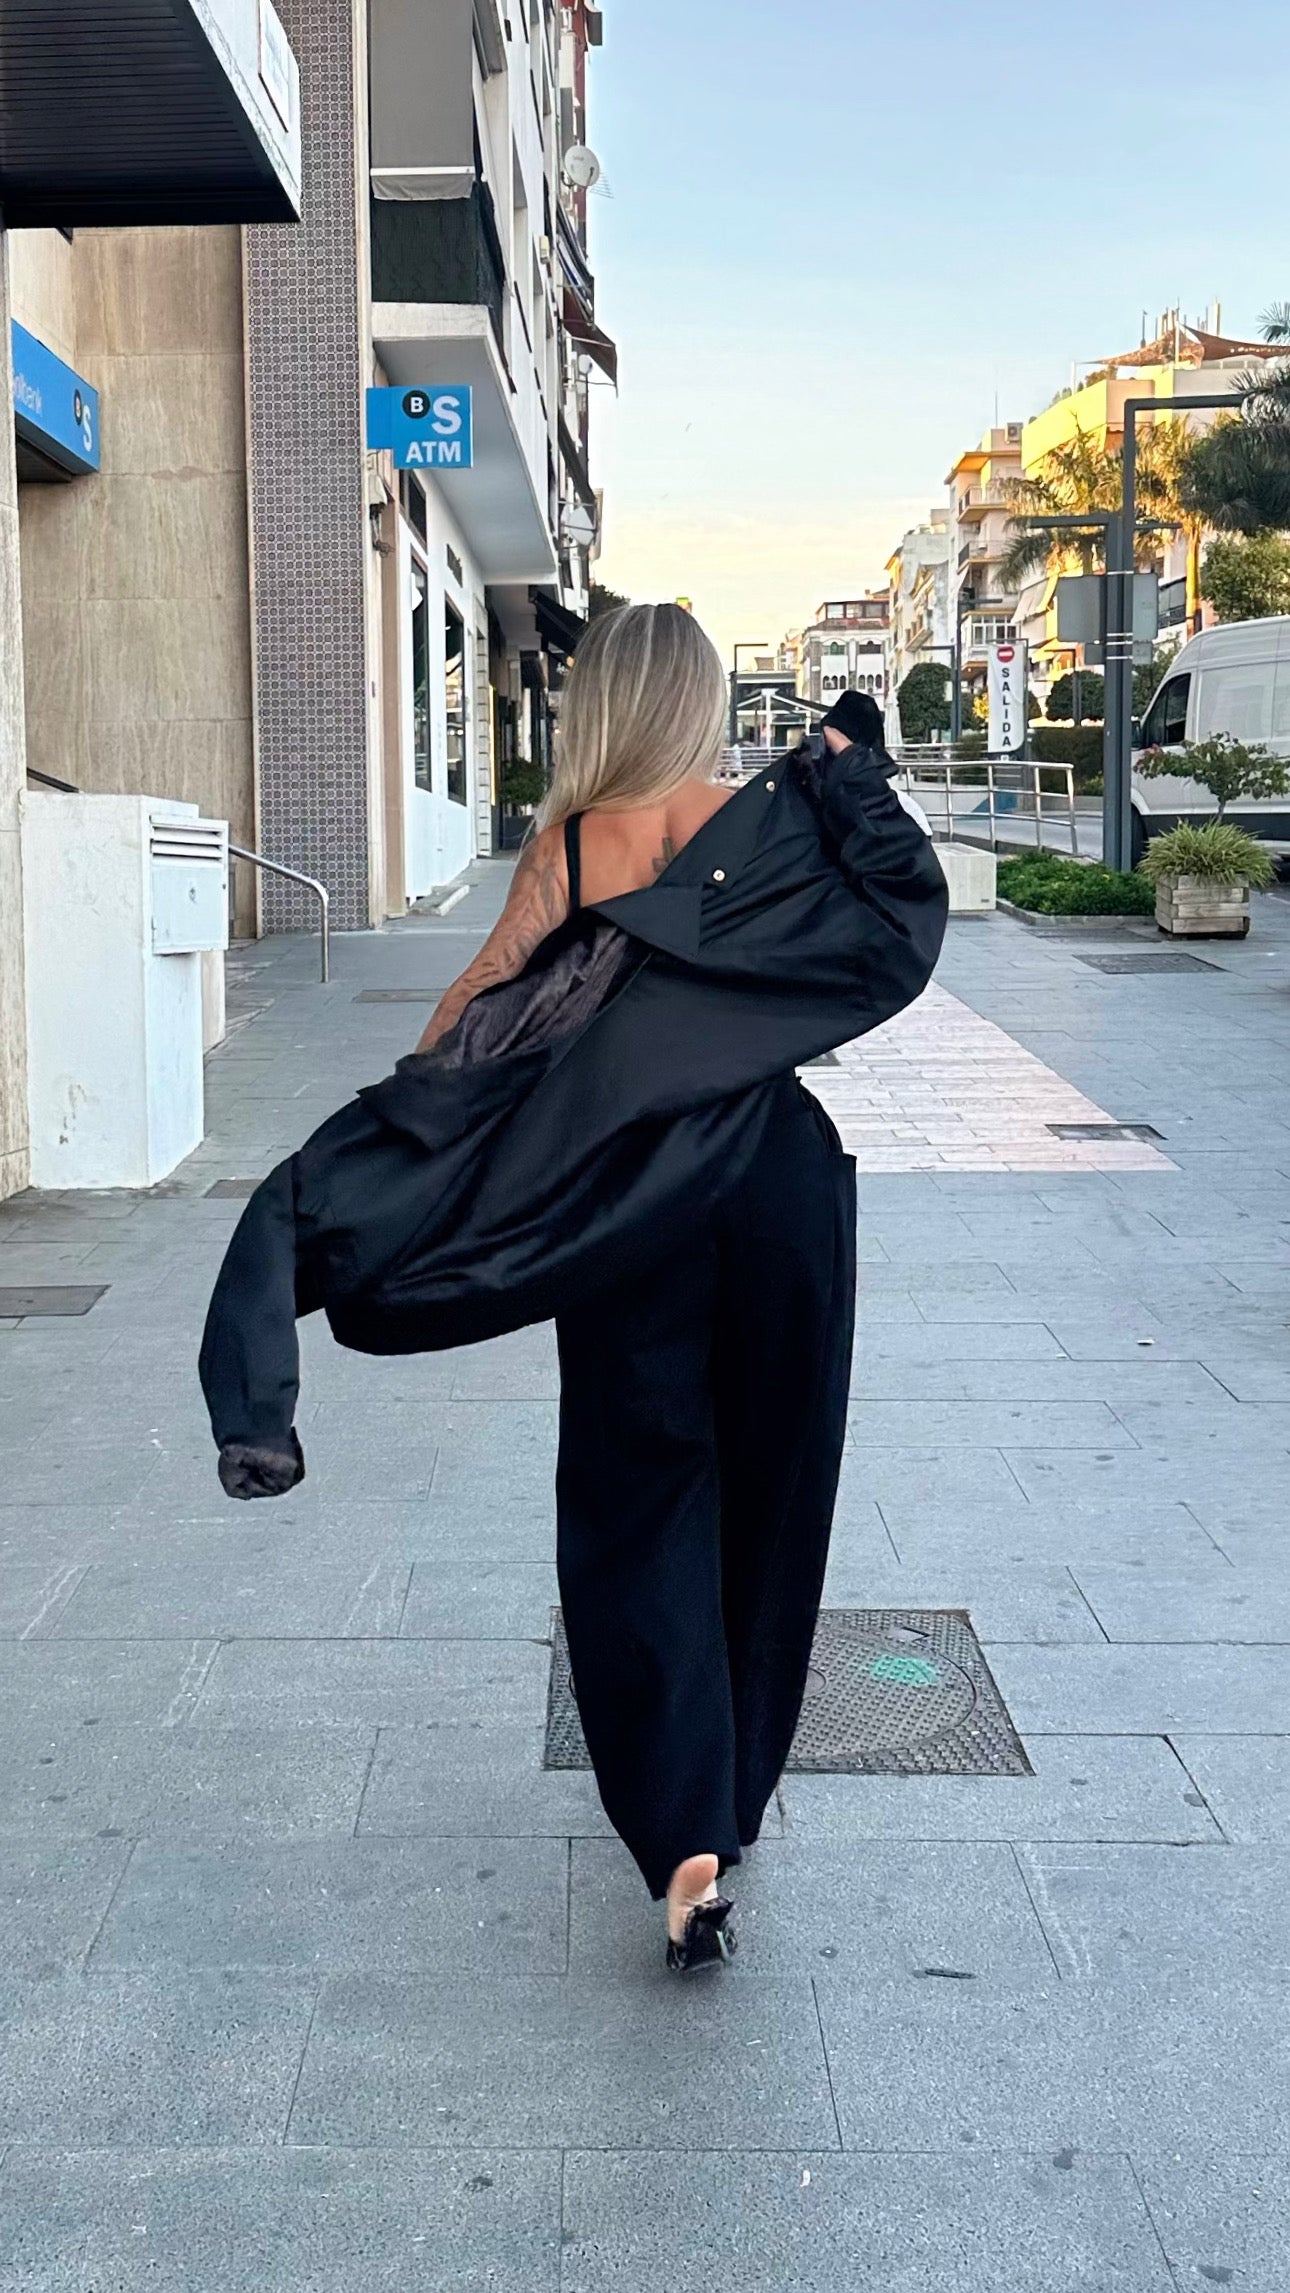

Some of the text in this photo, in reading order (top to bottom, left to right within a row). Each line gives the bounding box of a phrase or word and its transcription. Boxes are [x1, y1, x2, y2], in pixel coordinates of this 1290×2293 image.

[83, 405, 92, 452] S
[410, 395, 462, 435] B S
[405, 440, 462, 464] ATM
[1001, 667, 1012, 747] SALIDA
